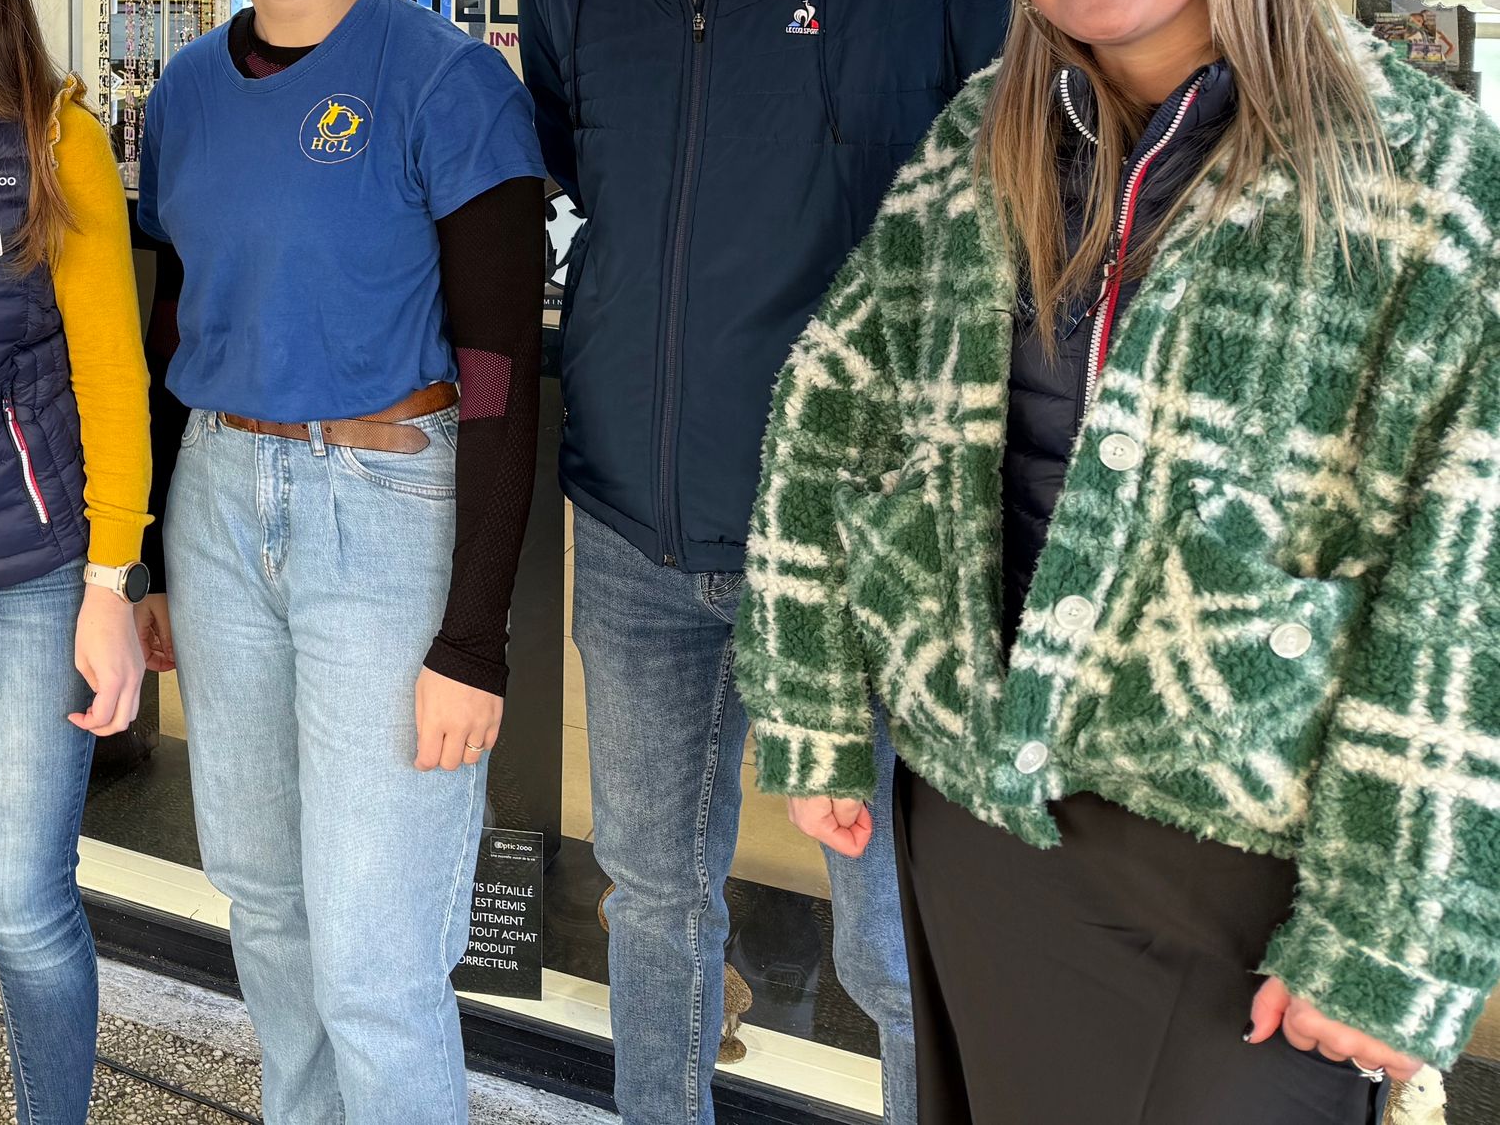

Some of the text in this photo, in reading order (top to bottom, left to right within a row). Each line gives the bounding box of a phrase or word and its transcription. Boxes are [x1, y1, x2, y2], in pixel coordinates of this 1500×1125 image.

[311, 137, 352, 153] HCL
[494, 841, 515, 850] Optic
[487, 882, 533, 897] DÉTAILLÉ
[475, 898, 526, 911] EST REMIS
[471, 911, 524, 926] UITEMENT
[470, 926, 537, 942] TOUT ACHAT
[469, 941, 515, 955] PRODUIT
[459, 955, 518, 970] ORRECTEUR
